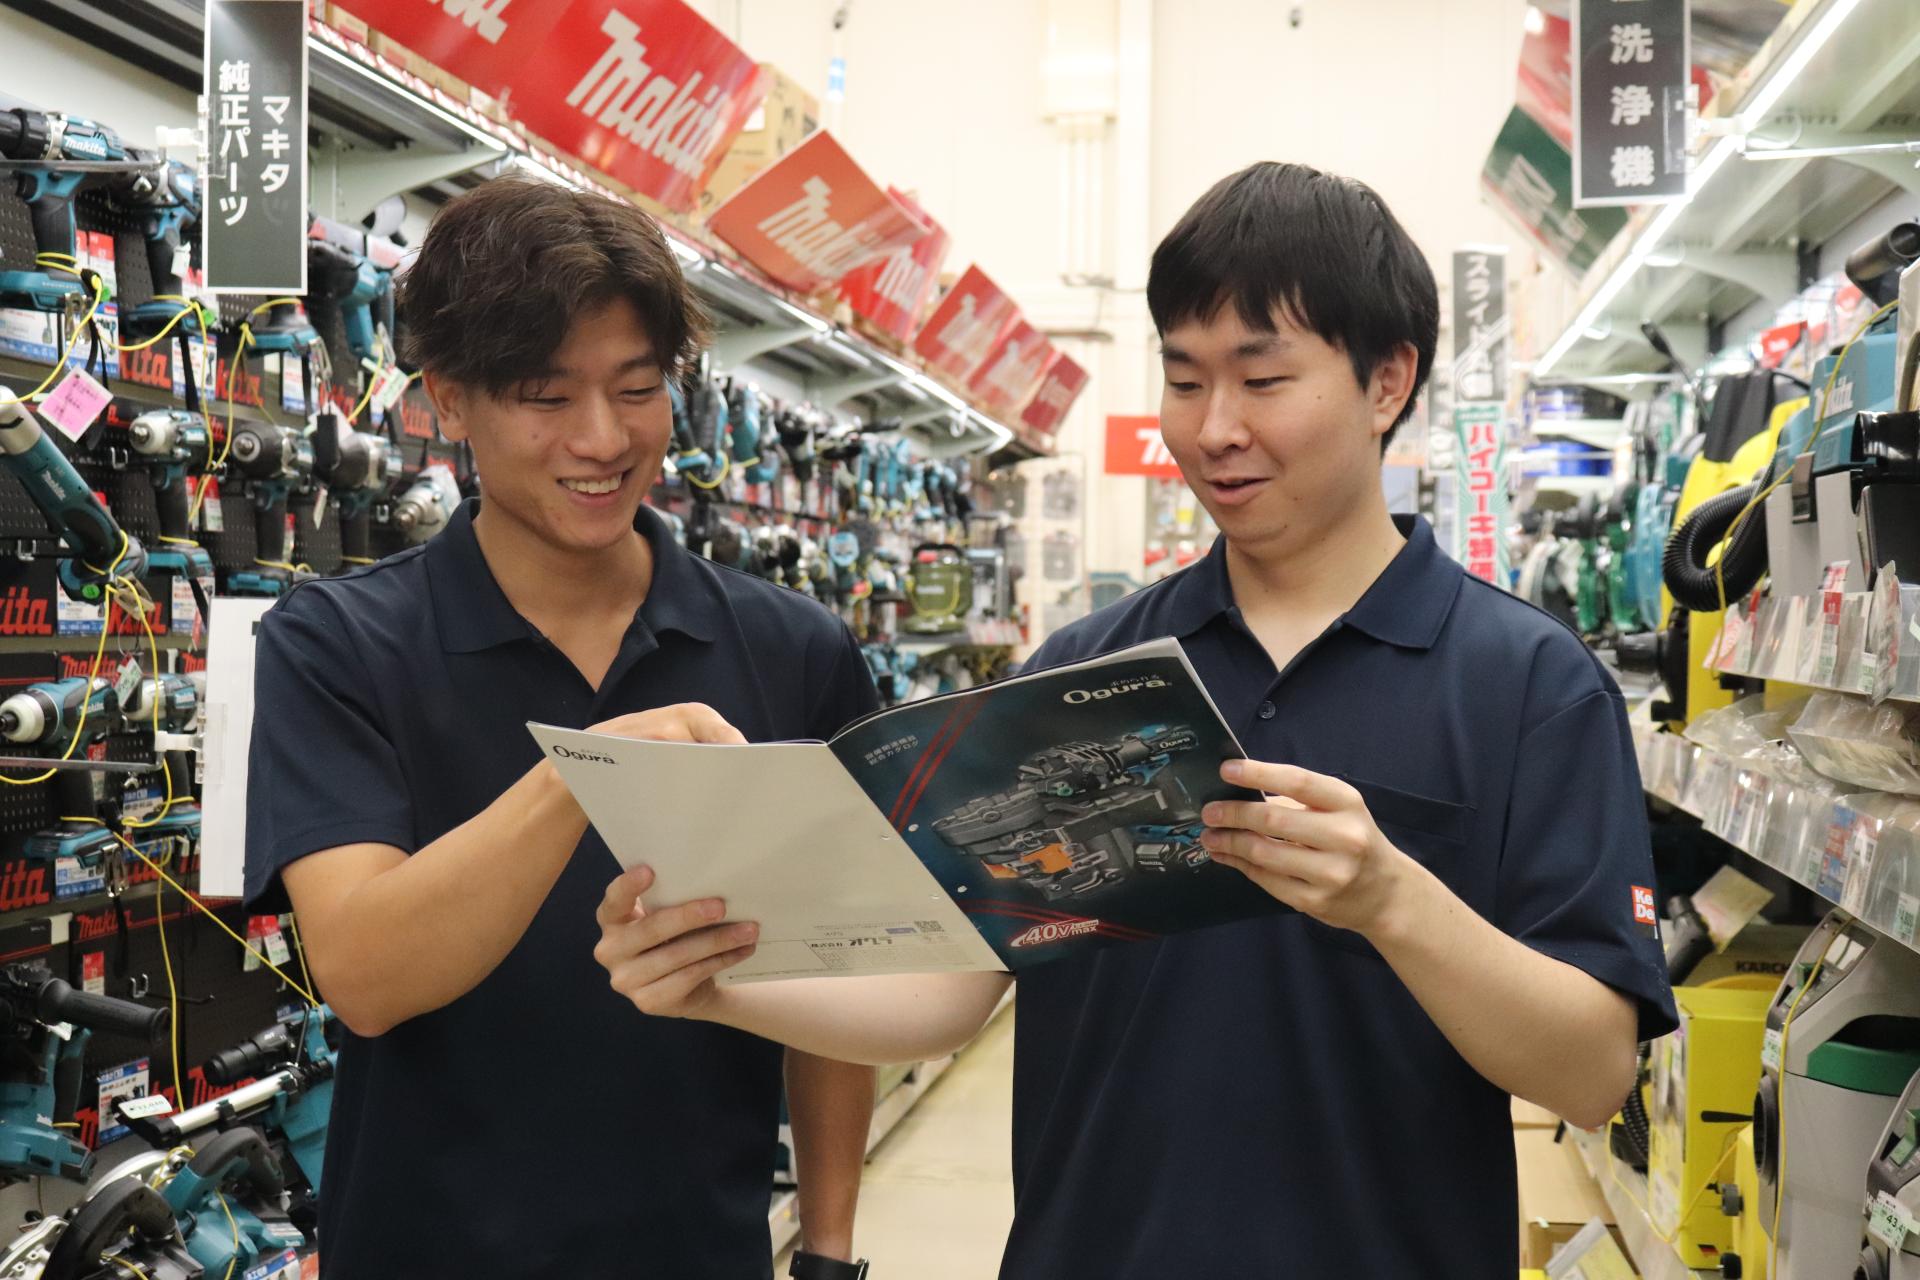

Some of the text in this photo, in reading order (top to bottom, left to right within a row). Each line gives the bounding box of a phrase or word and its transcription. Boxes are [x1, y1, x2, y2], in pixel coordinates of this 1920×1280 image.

[1610, 0, 1655, 187] 洗浄機
[219, 60, 251, 226] 純正パーツ
[260, 96, 291, 193] マキタ
[1063, 679, 1167, 704] Ogura
[553, 745, 615, 764] Ogura
